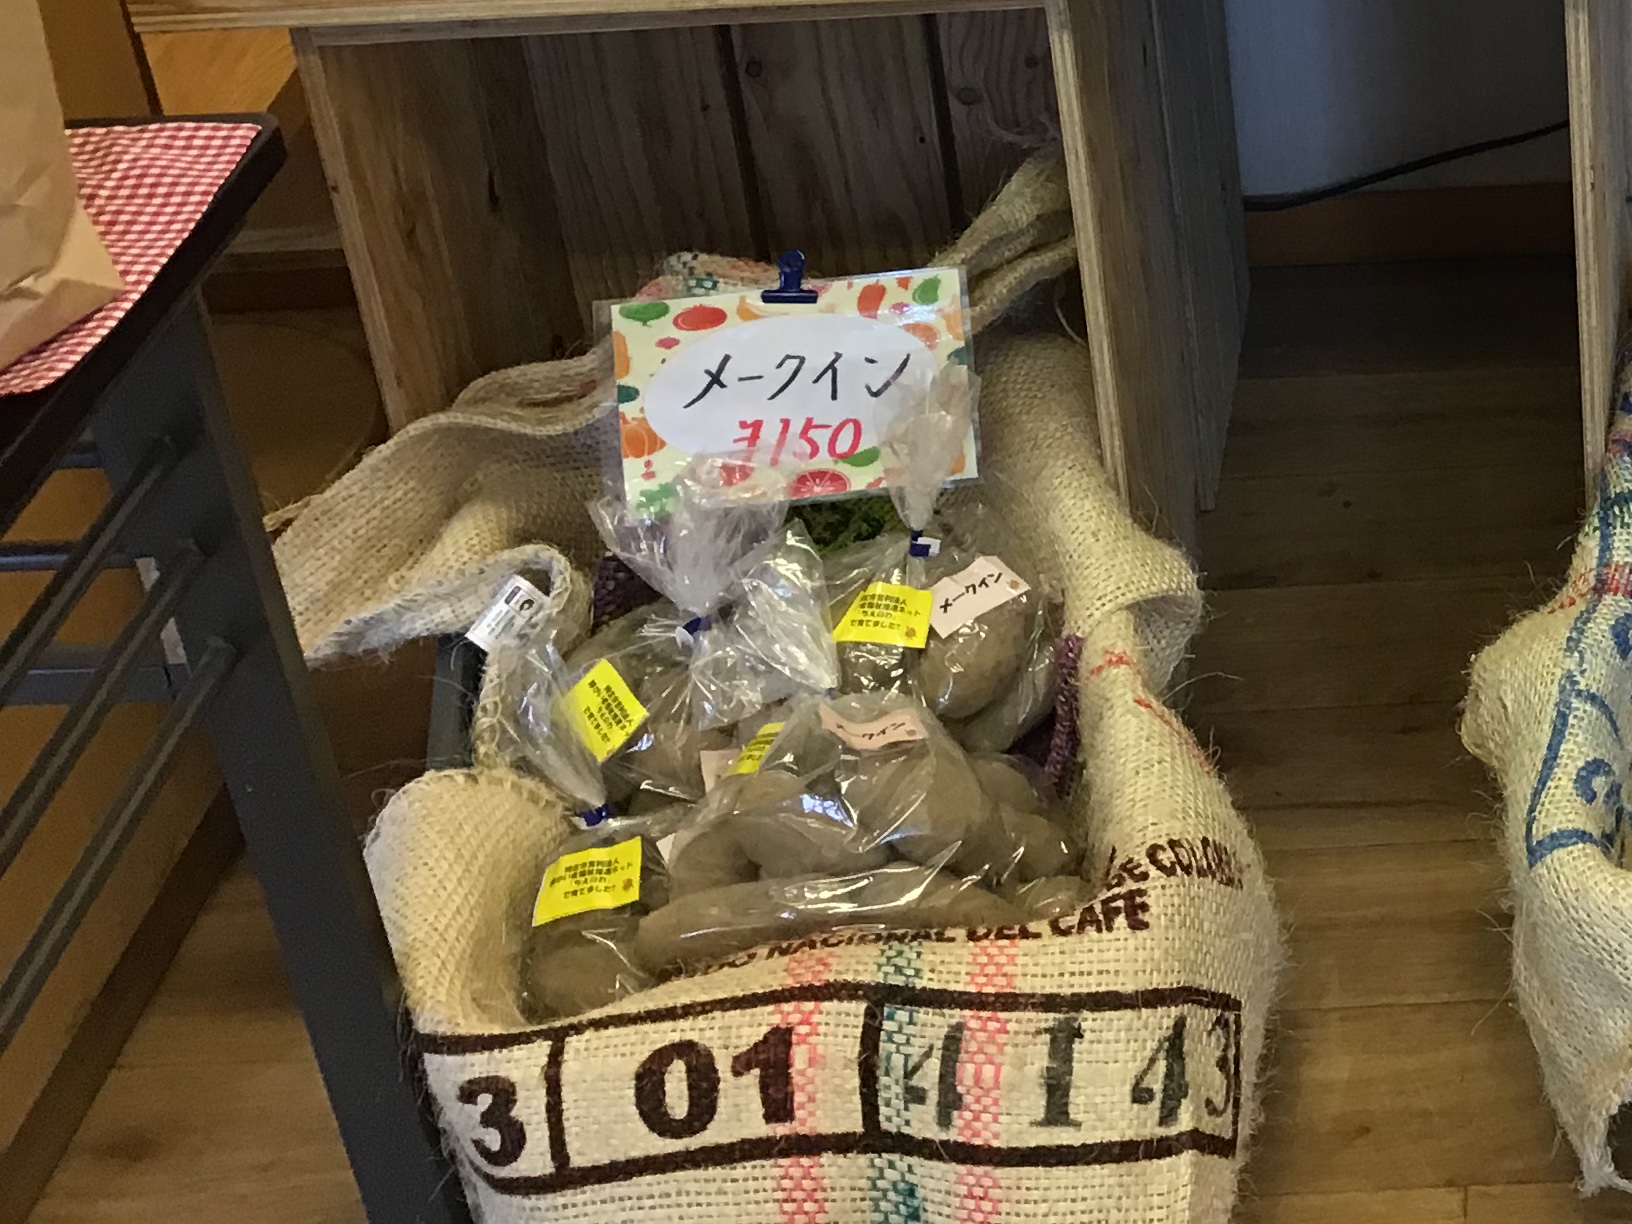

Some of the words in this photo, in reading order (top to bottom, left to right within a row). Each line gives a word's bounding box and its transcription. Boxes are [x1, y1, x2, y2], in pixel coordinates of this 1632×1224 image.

[683, 351, 912, 409] メークイン
[939, 572, 1003, 614] メークイン
[1049, 887, 1151, 938] CAFE
[633, 1023, 797, 1140] 01
